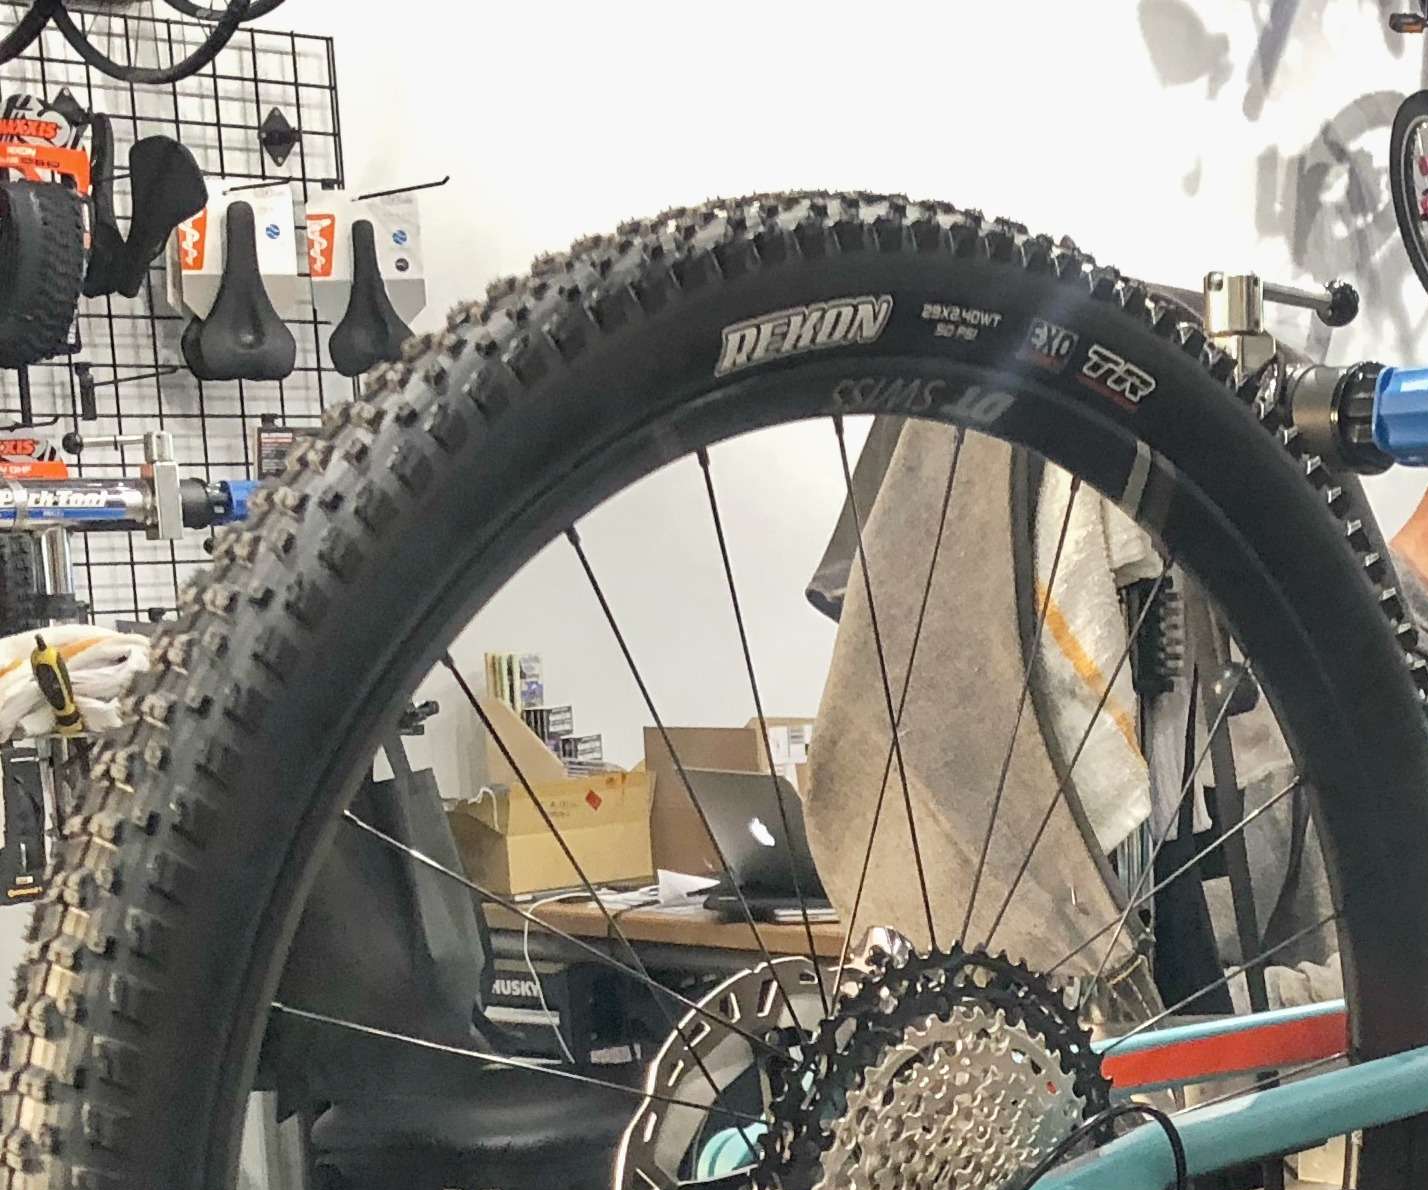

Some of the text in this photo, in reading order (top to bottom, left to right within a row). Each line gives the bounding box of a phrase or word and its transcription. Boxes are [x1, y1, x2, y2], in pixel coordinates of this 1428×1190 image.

[713, 293, 895, 379] REKON
[1080, 343, 1158, 405] TR
[491, 978, 541, 998] HUSKY
